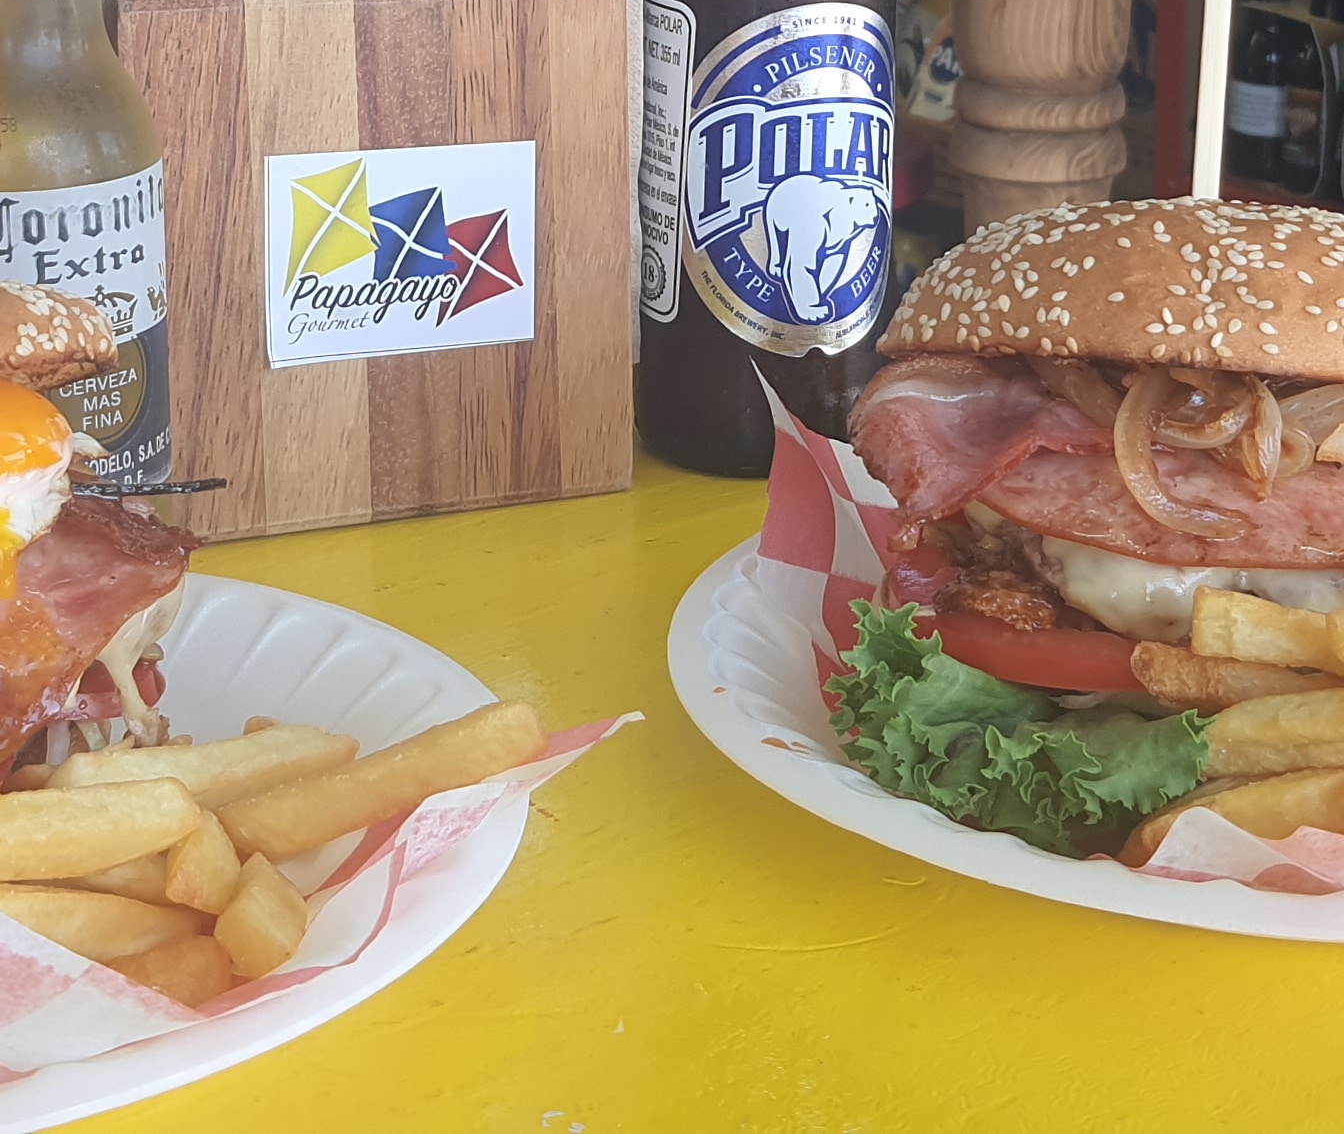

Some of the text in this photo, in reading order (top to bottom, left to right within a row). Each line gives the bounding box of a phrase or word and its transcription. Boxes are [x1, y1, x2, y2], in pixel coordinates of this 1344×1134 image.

[660, 13, 684, 36] POLAR
[792, 16, 827, 29] SINCE
[660, 43, 672, 65] 355
[763, 45, 877, 83] PILSENER
[698, 111, 892, 221] POLAR
[664, 214, 676, 231] DE
[32, 242, 146, 285] Extra
[722, 247, 776, 303] TYPE
[849, 245, 883, 299] BEER
[289, 274, 458, 323] Papagayo
[709, 284, 735, 315] FLORIDA
[287, 310, 371, 346] Gourmet
[59, 367, 138, 398] CERVEZA
[83, 390, 122, 413] MAS
[82, 409, 124, 432] FINA
[85, 450, 135, 477] ODELO,
